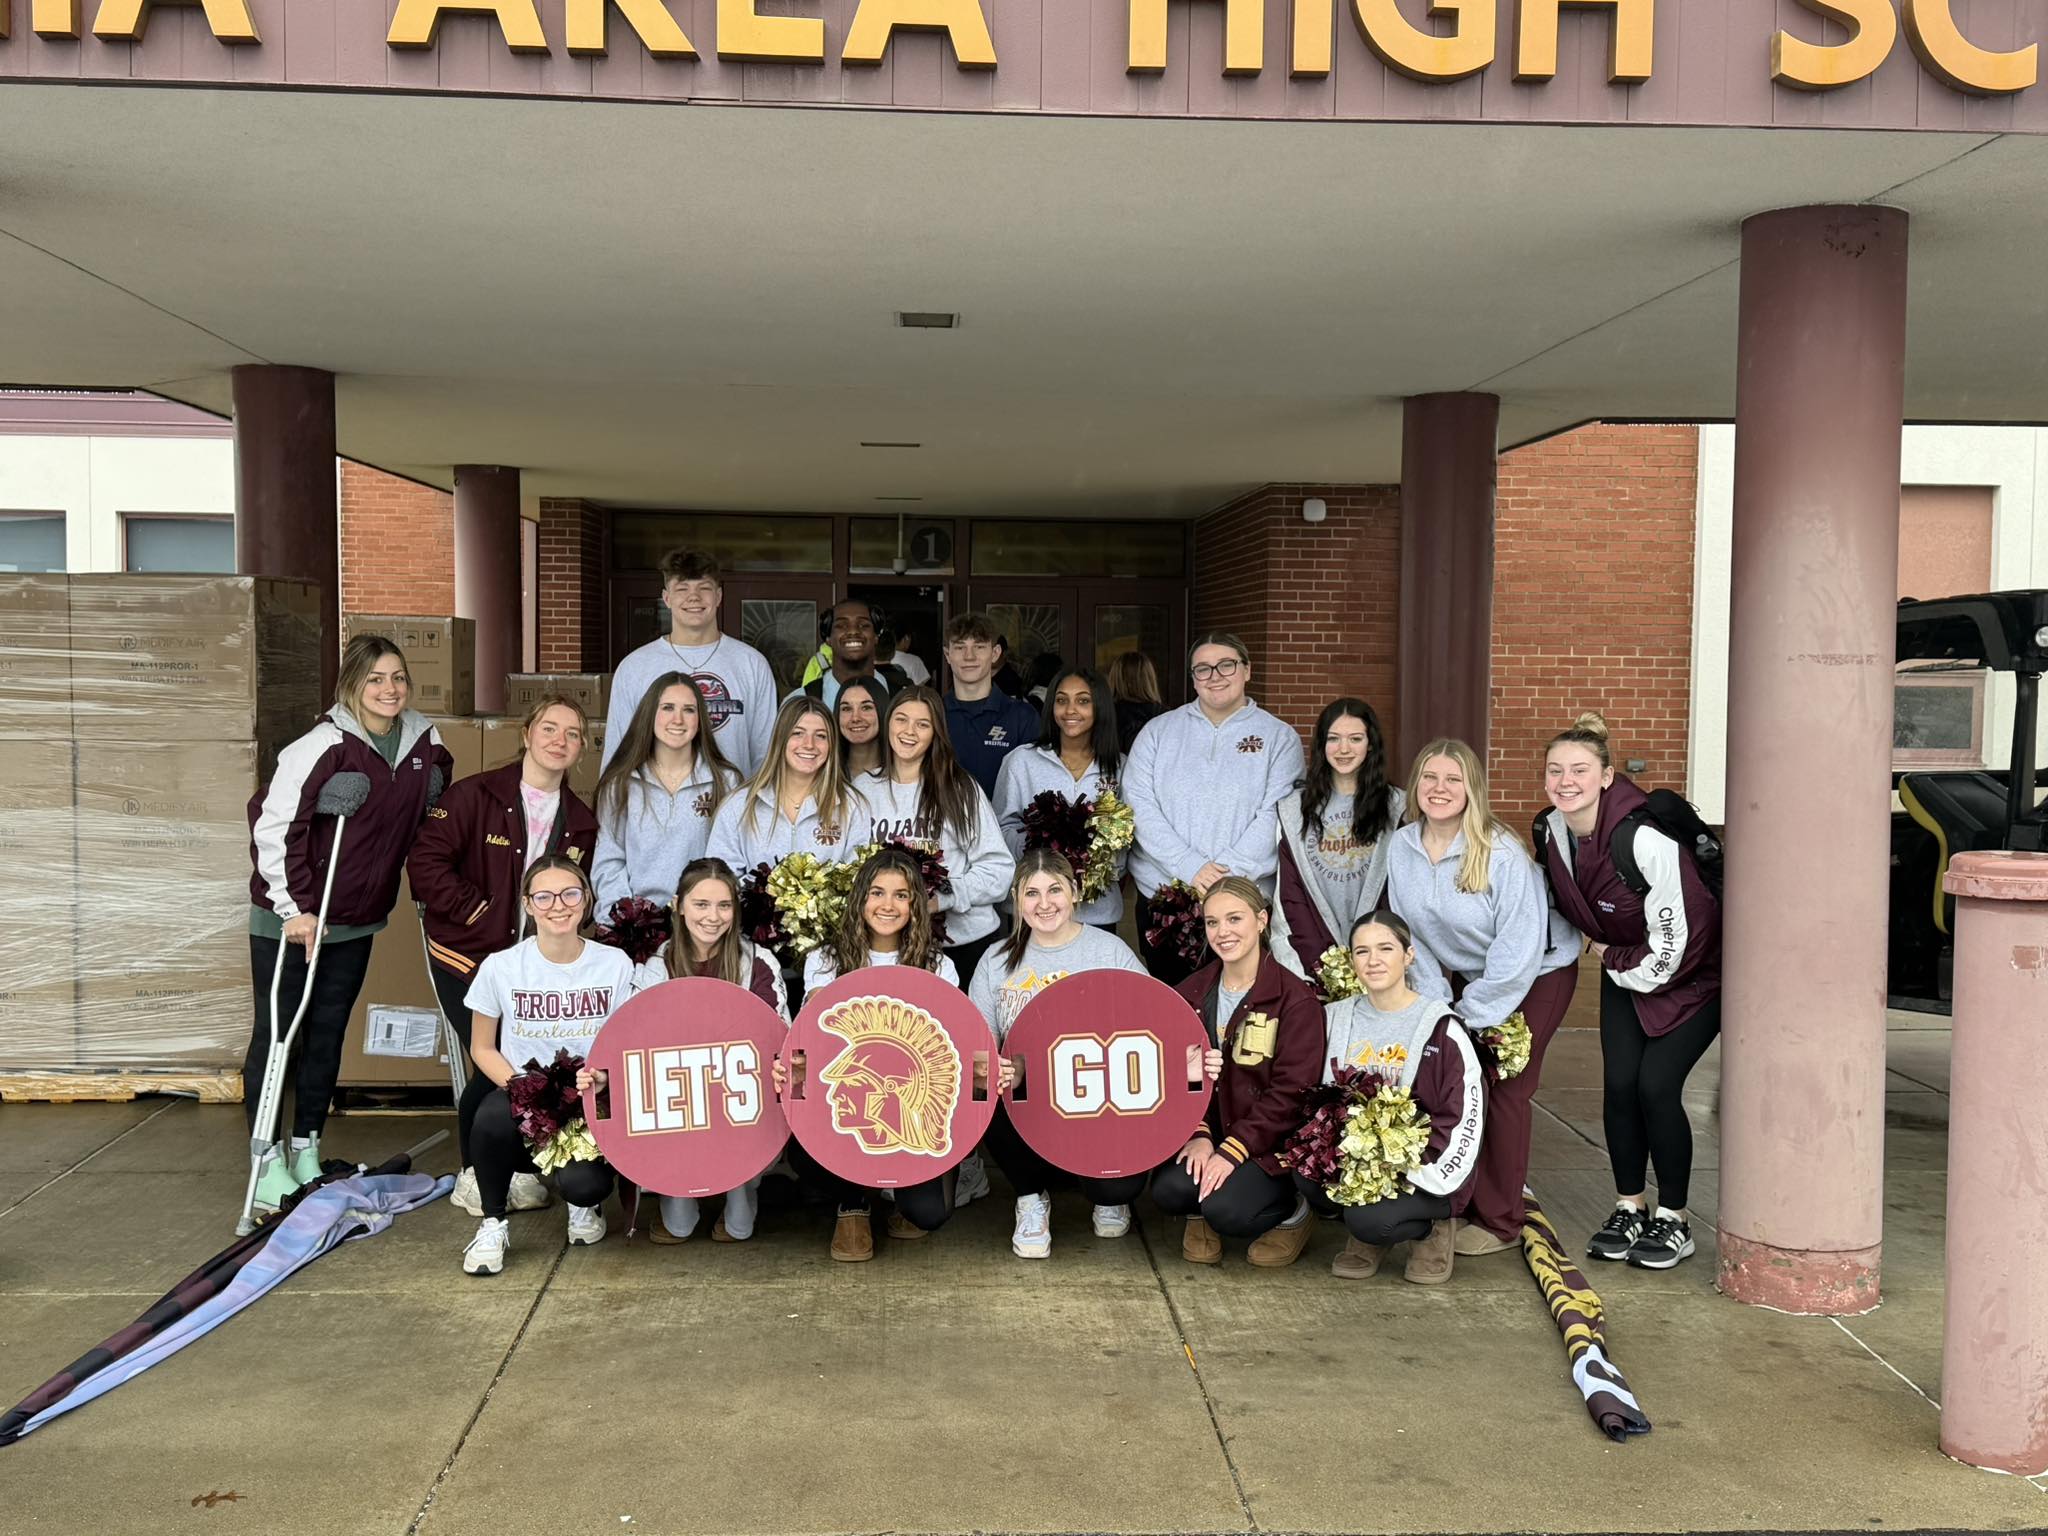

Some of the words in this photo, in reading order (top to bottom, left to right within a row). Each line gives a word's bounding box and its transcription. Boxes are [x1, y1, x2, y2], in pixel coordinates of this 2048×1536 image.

[922, 532, 941, 562] 1
[512, 986, 613, 1022] TROJAN
[623, 1039, 764, 1137] LET'S
[1047, 1029, 1166, 1119] GO
[1439, 1084, 1479, 1180] Cheerleader
